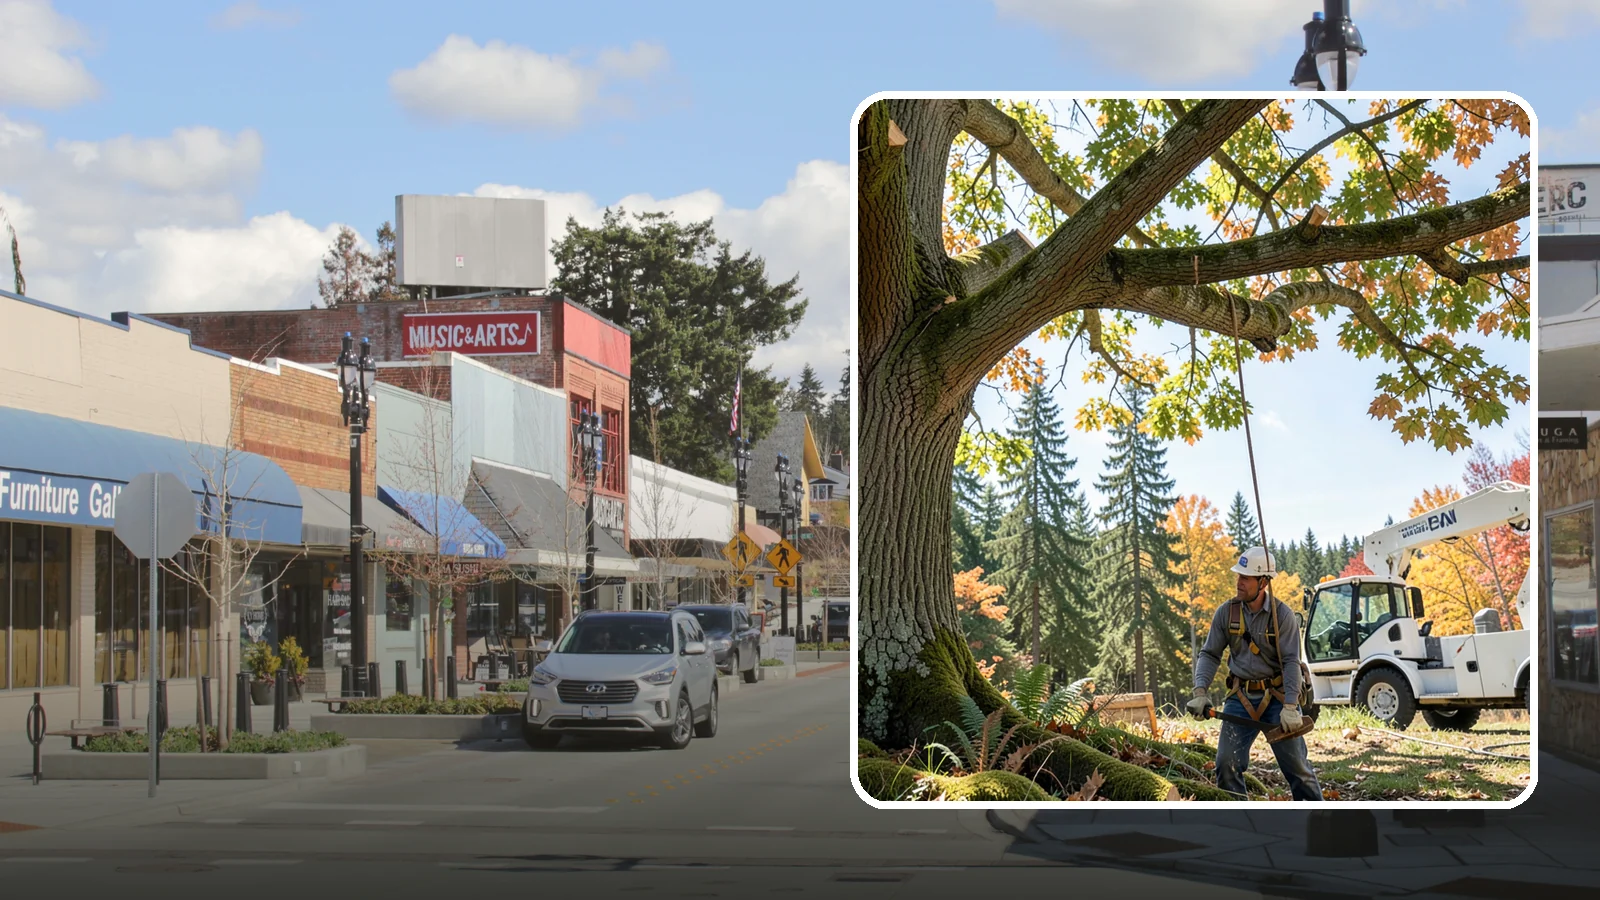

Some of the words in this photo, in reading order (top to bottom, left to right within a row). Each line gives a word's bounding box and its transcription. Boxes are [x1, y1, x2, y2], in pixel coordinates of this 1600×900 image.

[409, 322, 519, 349] MUSIC&ARTS
[0, 471, 79, 515] Furniture
[453, 563, 479, 574] SUSHI
